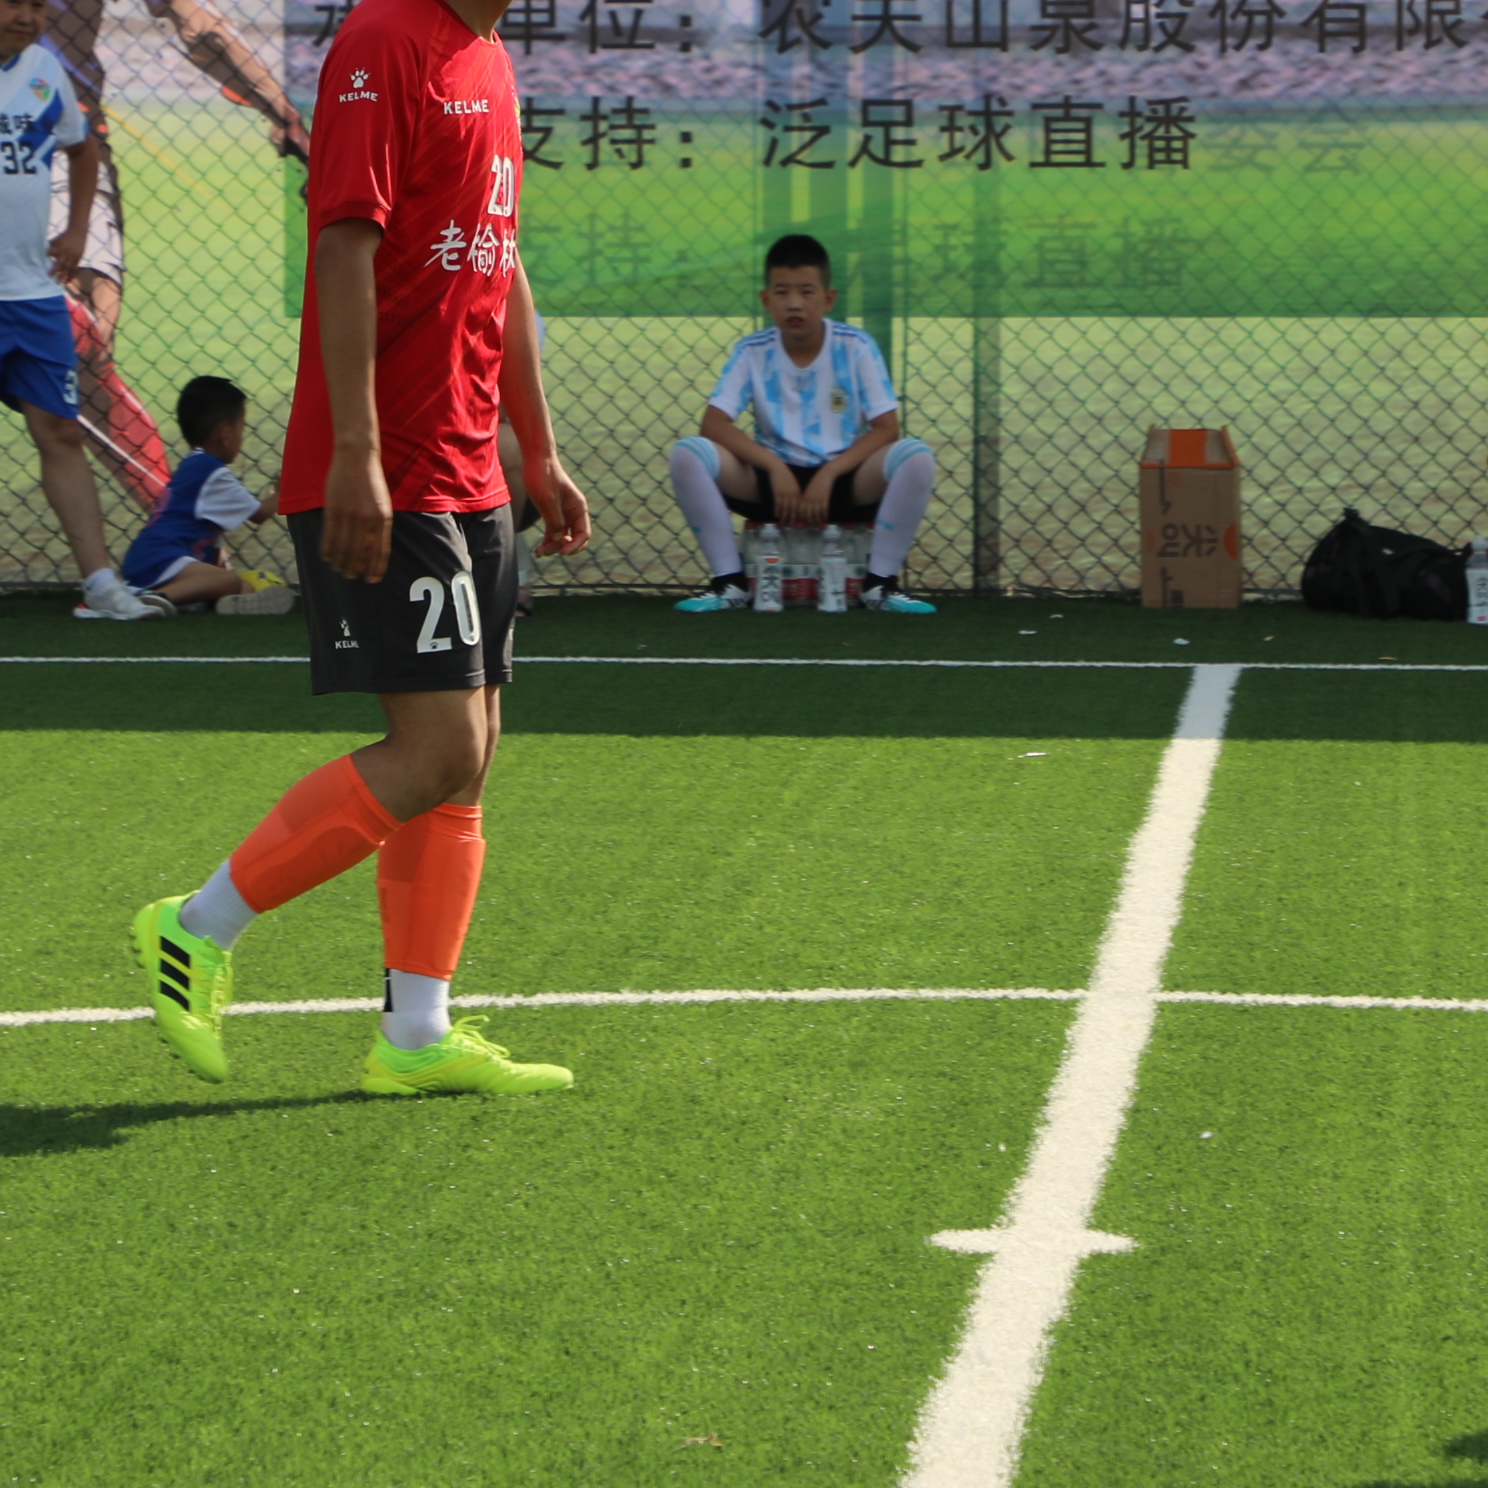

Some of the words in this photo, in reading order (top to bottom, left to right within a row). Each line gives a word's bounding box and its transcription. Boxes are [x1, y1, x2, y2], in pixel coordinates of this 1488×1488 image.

[339, 91, 378, 102] KELME
[444, 99, 490, 114] KELME
[0, 141, 38, 175] 32
[488, 154, 515, 218] 20
[409, 571, 481, 653] 20
